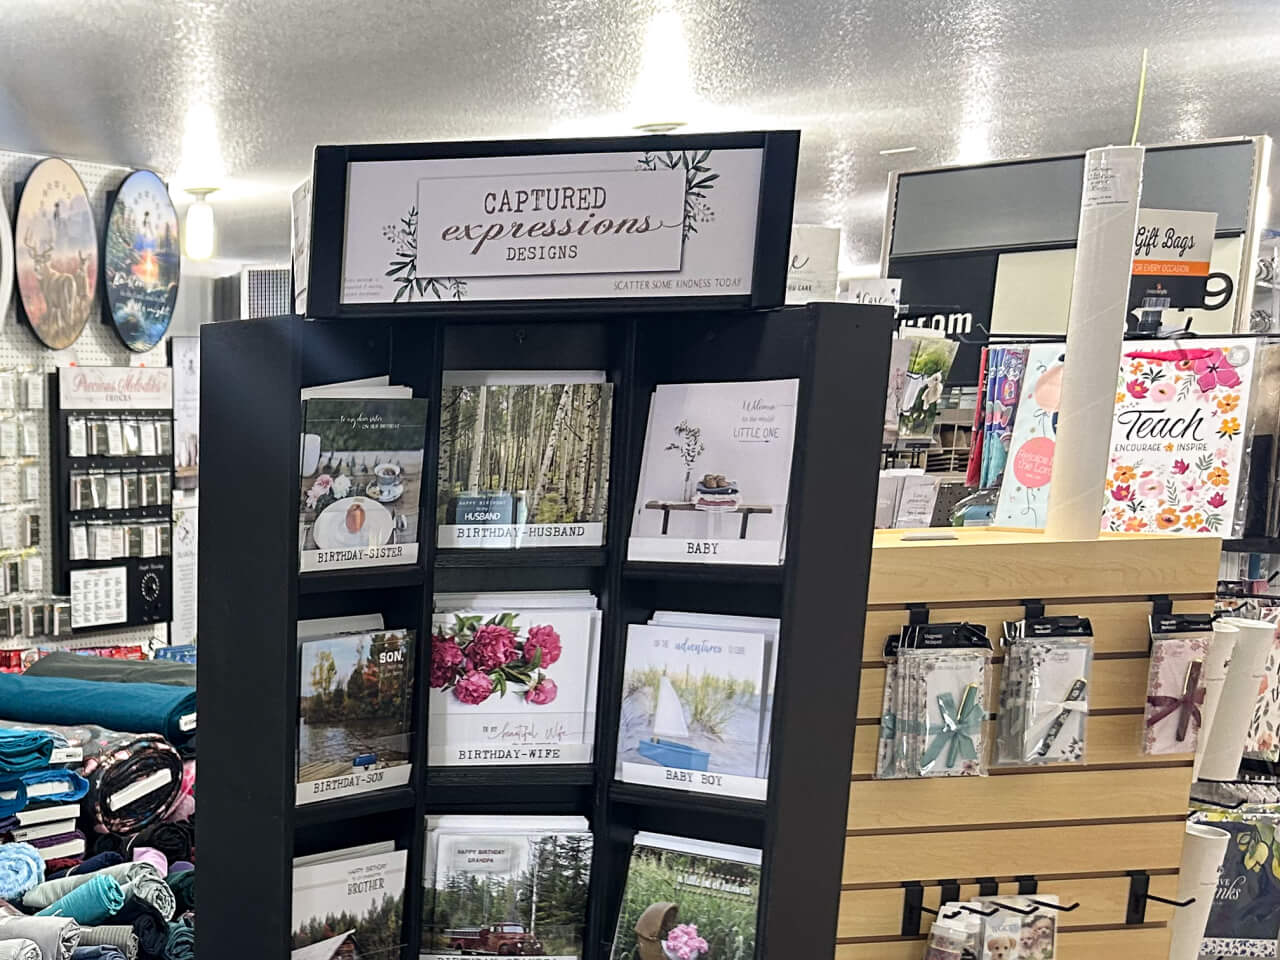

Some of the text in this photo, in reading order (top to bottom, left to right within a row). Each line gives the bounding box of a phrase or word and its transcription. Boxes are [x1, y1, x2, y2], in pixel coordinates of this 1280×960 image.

[483, 186, 607, 214] CAPTURED
[442, 214, 655, 255] expressions
[1134, 226, 1196, 257] Gift Bags
[506, 245, 579, 262] DESIGNS
[613, 278, 742, 291] SCATTER SOME KINDNESS TODAY
[733, 427, 780, 438] LITTLE ONE
[1117, 408, 1204, 441] Teach
[1115, 443, 1208, 452] ENCOURAGE INSPIRE
[465, 512, 501, 521] HUSBAND
[457, 526, 585, 539] BIRTHDAY-HUSBAND
[317, 546, 403, 563] BIRTHDAY-SISTER
[686, 542, 719, 554] BABY
[458, 749, 561, 760] BIRTHDAY-WIFE
[313, 771, 384, 794] BIRTHDAY-SON
[666, 769, 723, 786] BABY BOY
[347, 878, 385, 896] BROTHER
